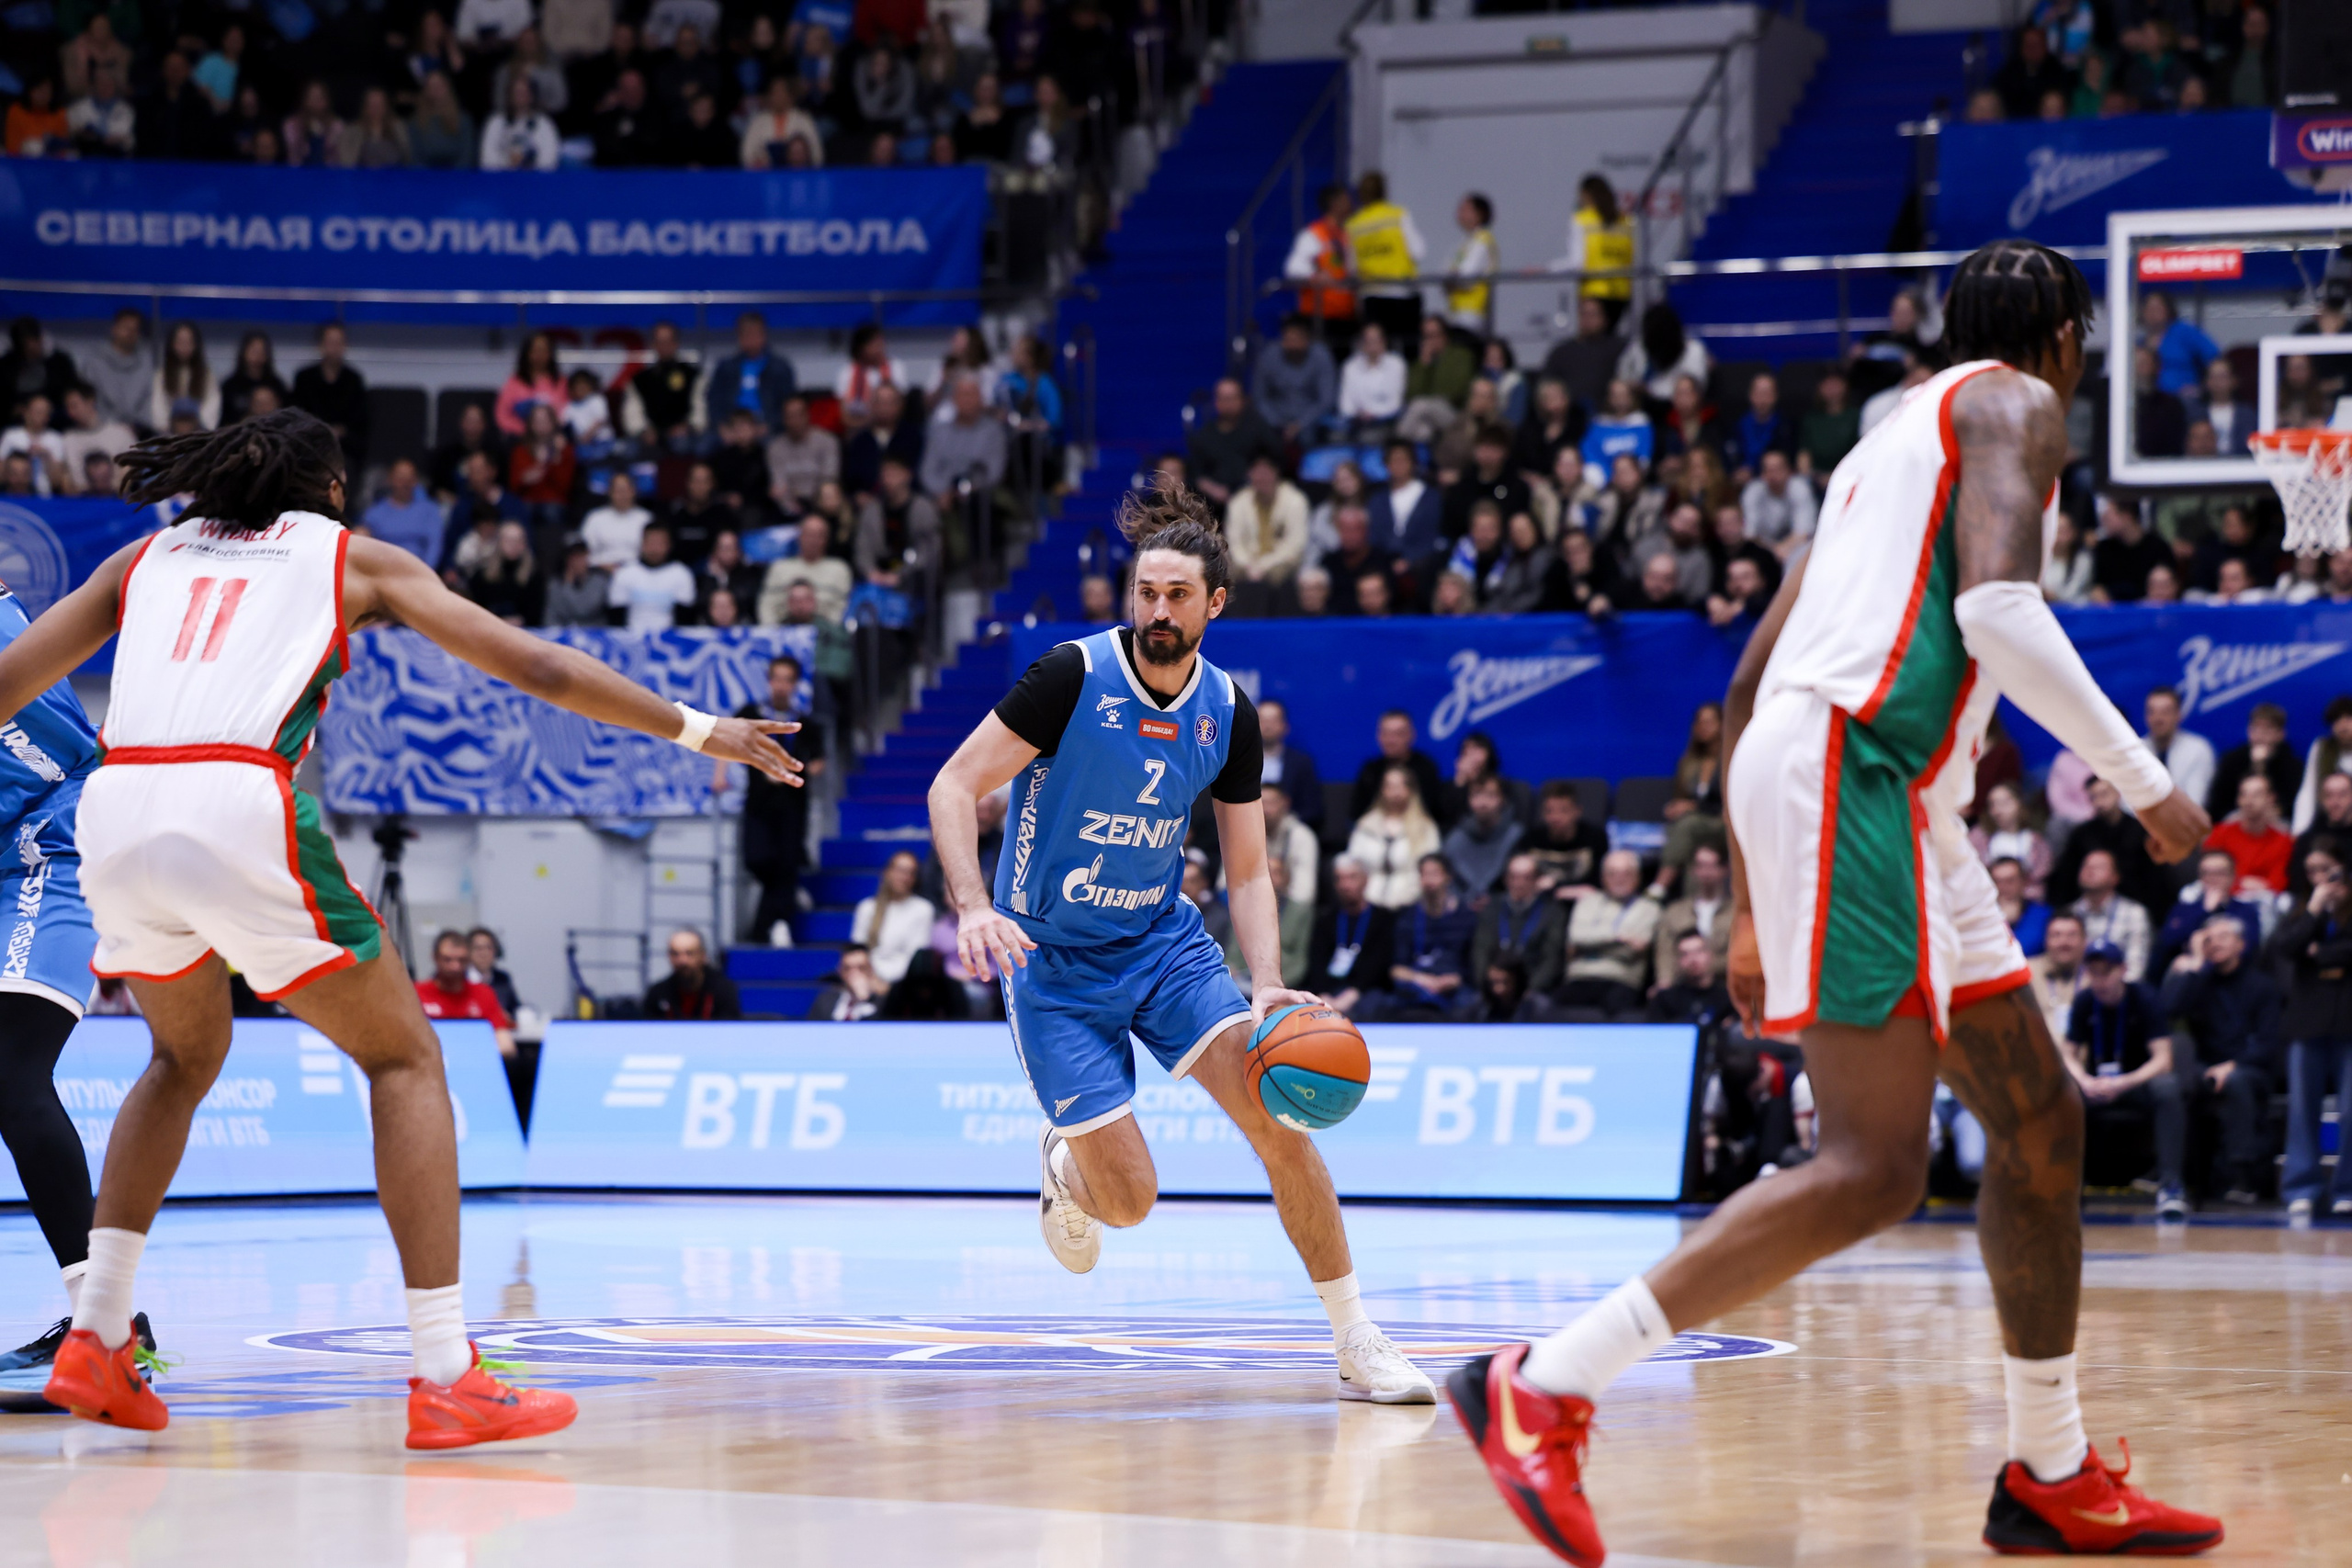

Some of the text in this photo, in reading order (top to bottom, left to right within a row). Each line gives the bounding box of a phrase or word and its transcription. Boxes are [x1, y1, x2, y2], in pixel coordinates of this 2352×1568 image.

[36, 209, 927, 260] СЕВЕРНАЯ СТОЛИЦА БАСКЕТБОЛА
[171, 577, 249, 663] 11
[1143, 724, 1173, 735] 80 ПОБЕДА!
[1136, 759, 1166, 806] 2
[1079, 809, 1185, 849] ZENIT
[682, 1073, 849, 1150] ВТБ
[938, 1083, 1040, 1111] ТИТУЛ
[1419, 1066, 1597, 1146] ВТБ
